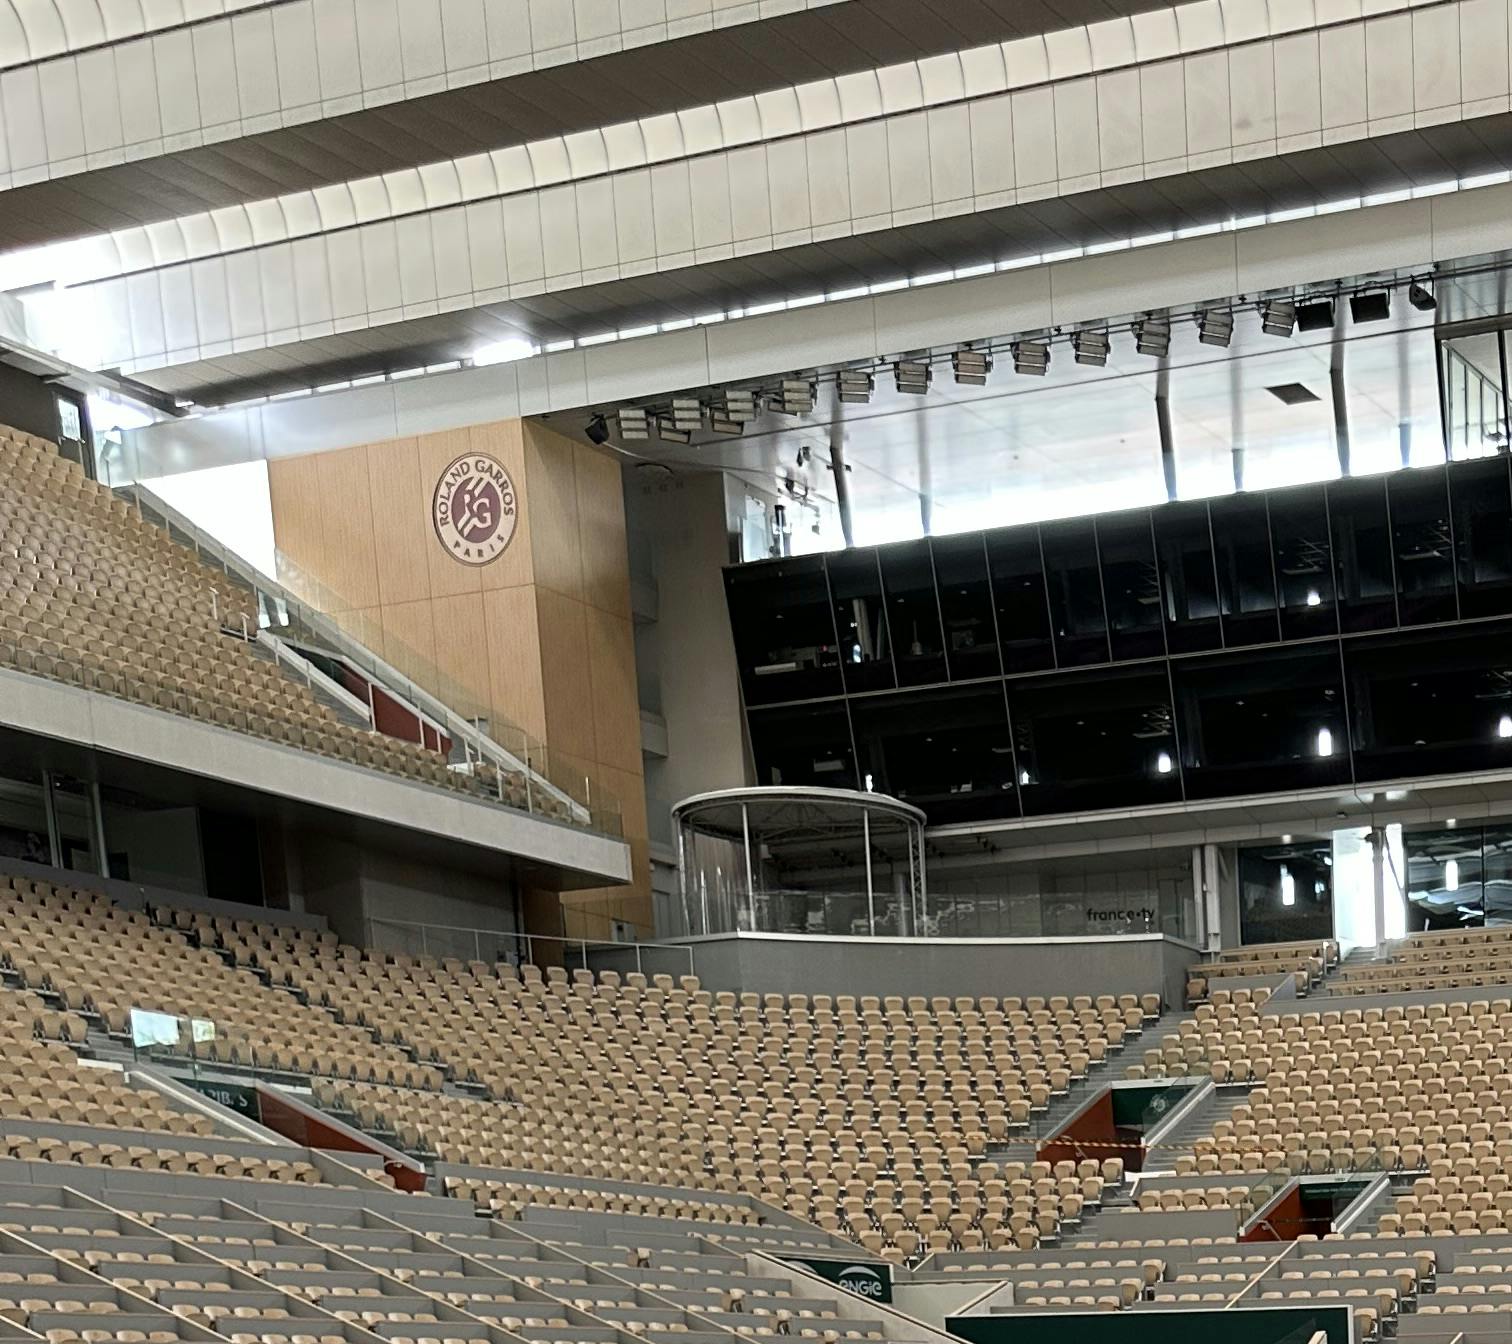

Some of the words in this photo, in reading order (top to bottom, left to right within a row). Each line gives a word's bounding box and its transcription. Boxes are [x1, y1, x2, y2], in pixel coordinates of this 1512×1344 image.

[438, 461, 470, 527] ROLAND
[475, 459, 514, 516] GARROS
[453, 534, 505, 557] PARIS
